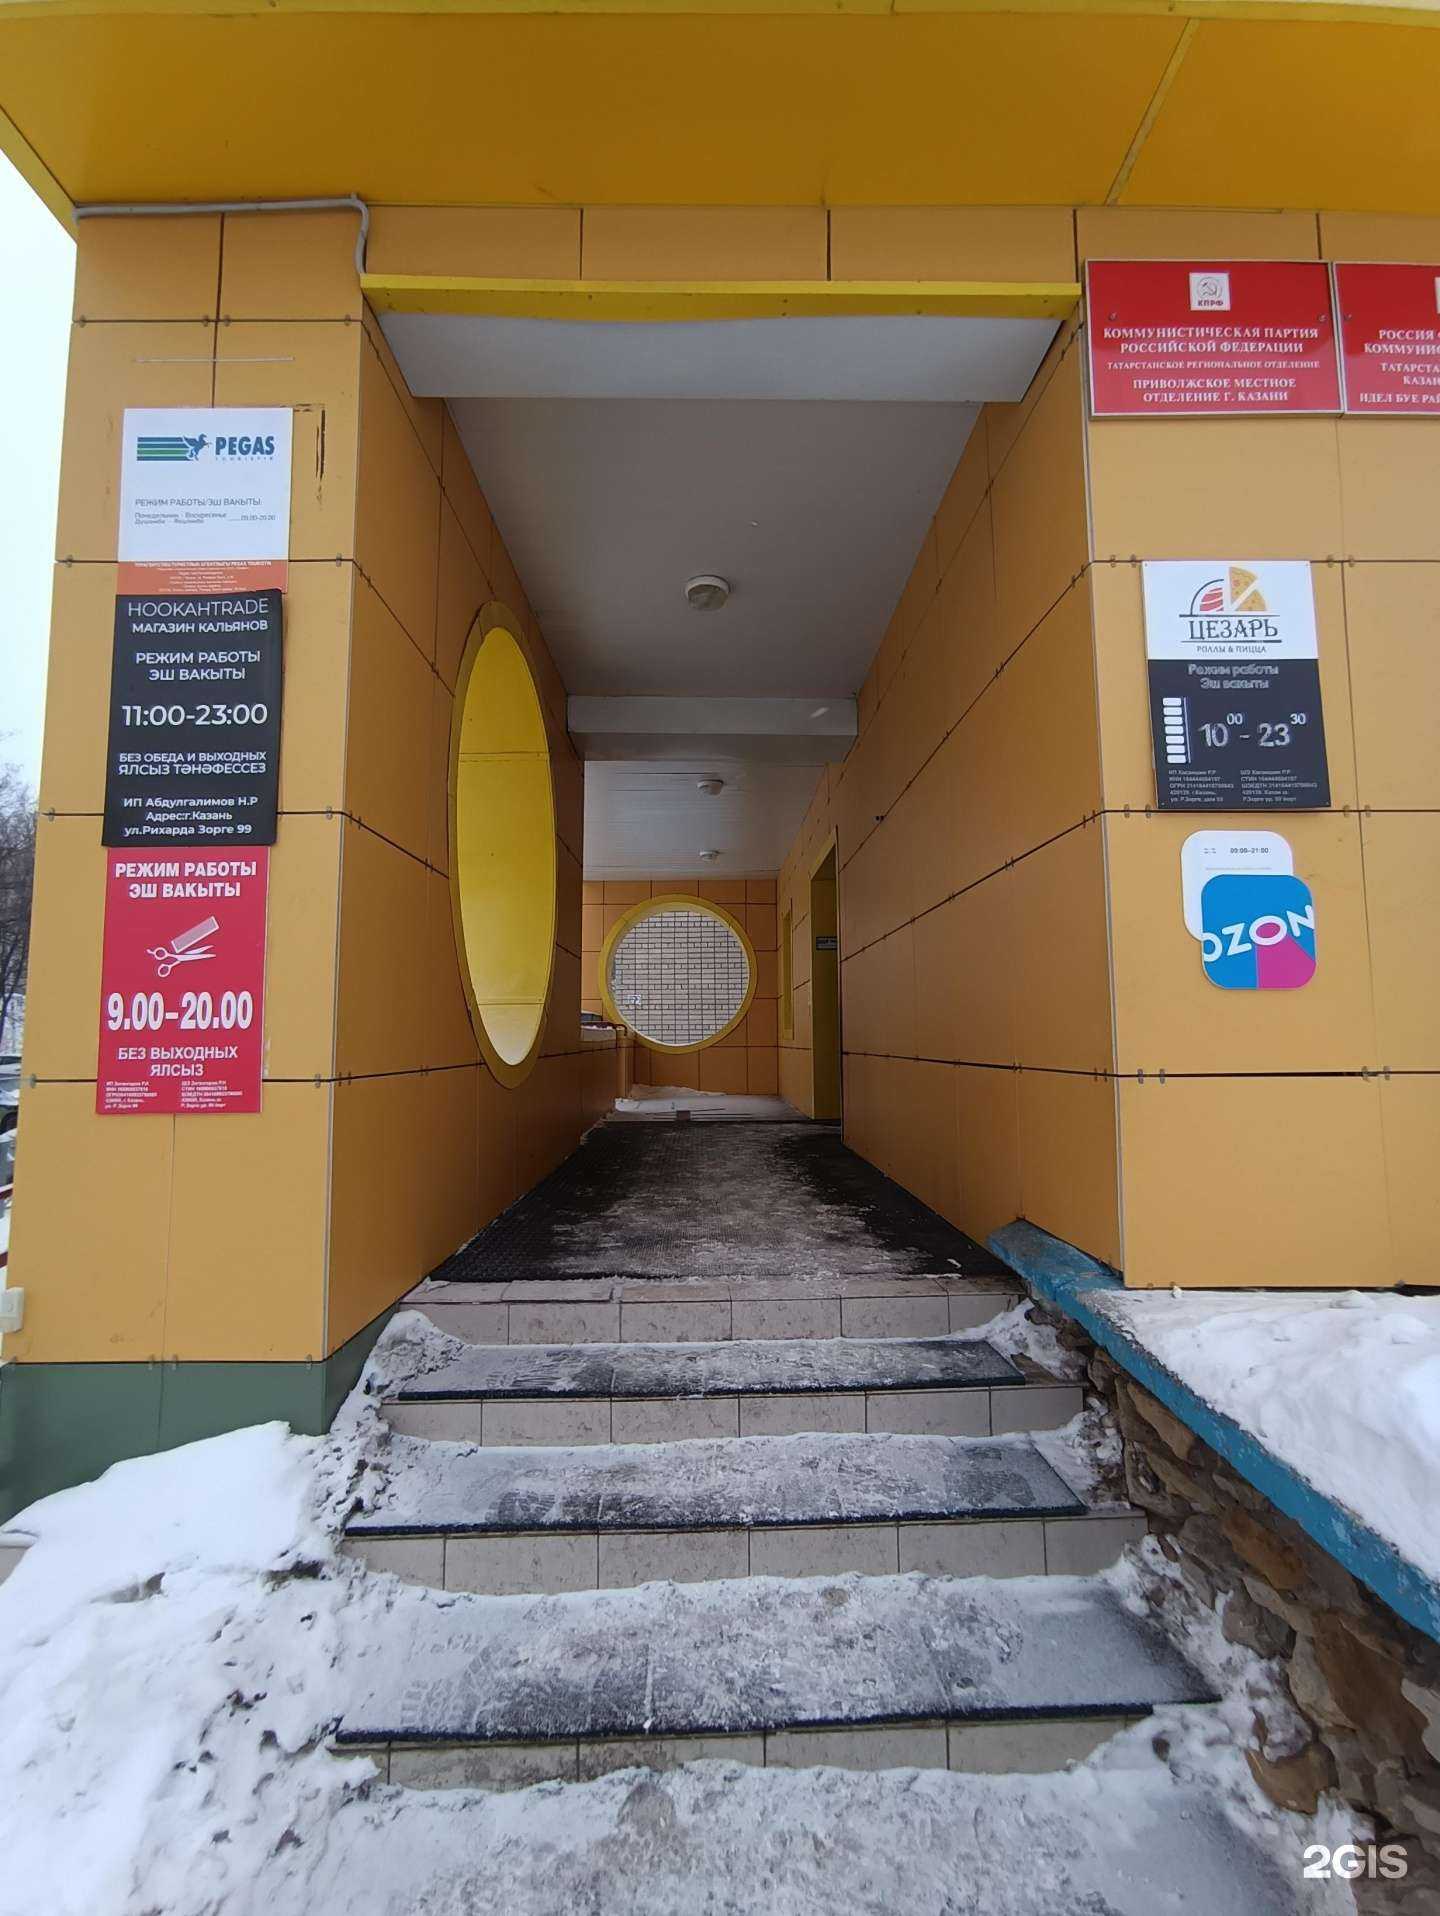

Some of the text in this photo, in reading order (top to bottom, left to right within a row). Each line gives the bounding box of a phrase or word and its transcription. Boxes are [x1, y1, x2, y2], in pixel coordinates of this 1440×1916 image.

[1103, 327, 1319, 340] КОММУНИСТИЧЕСКАЯ ПАРТИЯ
[1379, 330, 1434, 341] РОССИЯ
[1120, 340, 1303, 354] РОССИЙСКОЙ ФЕДЕРАЦИИ
[1364, 343, 1440, 355] КОММУНИ
[1107, 360, 1320, 370] ТАТАРСТАНСКОЕ РЕГИОНАЛЬНОЕ ОТДЕЛЕНИЕ
[1132, 378, 1296, 390] ПРИВОЛЖСКОЕ МЕСТНОЕ
[1143, 391, 1288, 403] ОТДЕЛЕНИЕ Г. КАЗАНИ
[1360, 393, 1393, 403] ИДЕЛ
[1396, 394, 1420, 403] БУЕ
[215, 436, 275, 456] PEGAS
[135, 499, 168, 507] РЕЖИМ
[223, 498, 261, 506] ВАКЫТЫ
[128, 598, 269, 617] HOOKAHTRADE
[132, 620, 268, 633] МАГАЗИН КАЛЬЯНОВ
[1188, 618, 1279, 640] ЦЕЗАРЬ
[1236, 645, 1267, 654] ПИЦЦА
[135, 651, 261, 664] РЕЖИМ РАБОТЫ
[148, 668, 246, 680] ЭШ ВАКЫТЫ
[1232, 664, 1279, 677] работы
[1200, 678, 1269, 689] Эш вакыты
[121, 703, 268, 726] 11:00-23:00
[119, 751, 267, 763] БЕЗ ОБЕДА И ВЫХОДНЫХ
[118, 763, 267, 775] ЯЛСЫЗ ТӘНӘФЕССЕЗ
[123, 796, 258, 808] ИП Абдулгалимов Н.Р
[124, 825, 252, 837] ул.Рихарда Зорге 99
[115, 861, 257, 878] РЕЖИМ РАБОТЫ
[129, 882, 241, 898] ЭШ ВАКЫТЫ
[107, 990, 254, 1031] 9.00-20.00
[118, 1046, 238, 1061] БЕЗ ВЫХОДНЫХ
[150, 1063, 204, 1077] ЯЛСЫЗ
